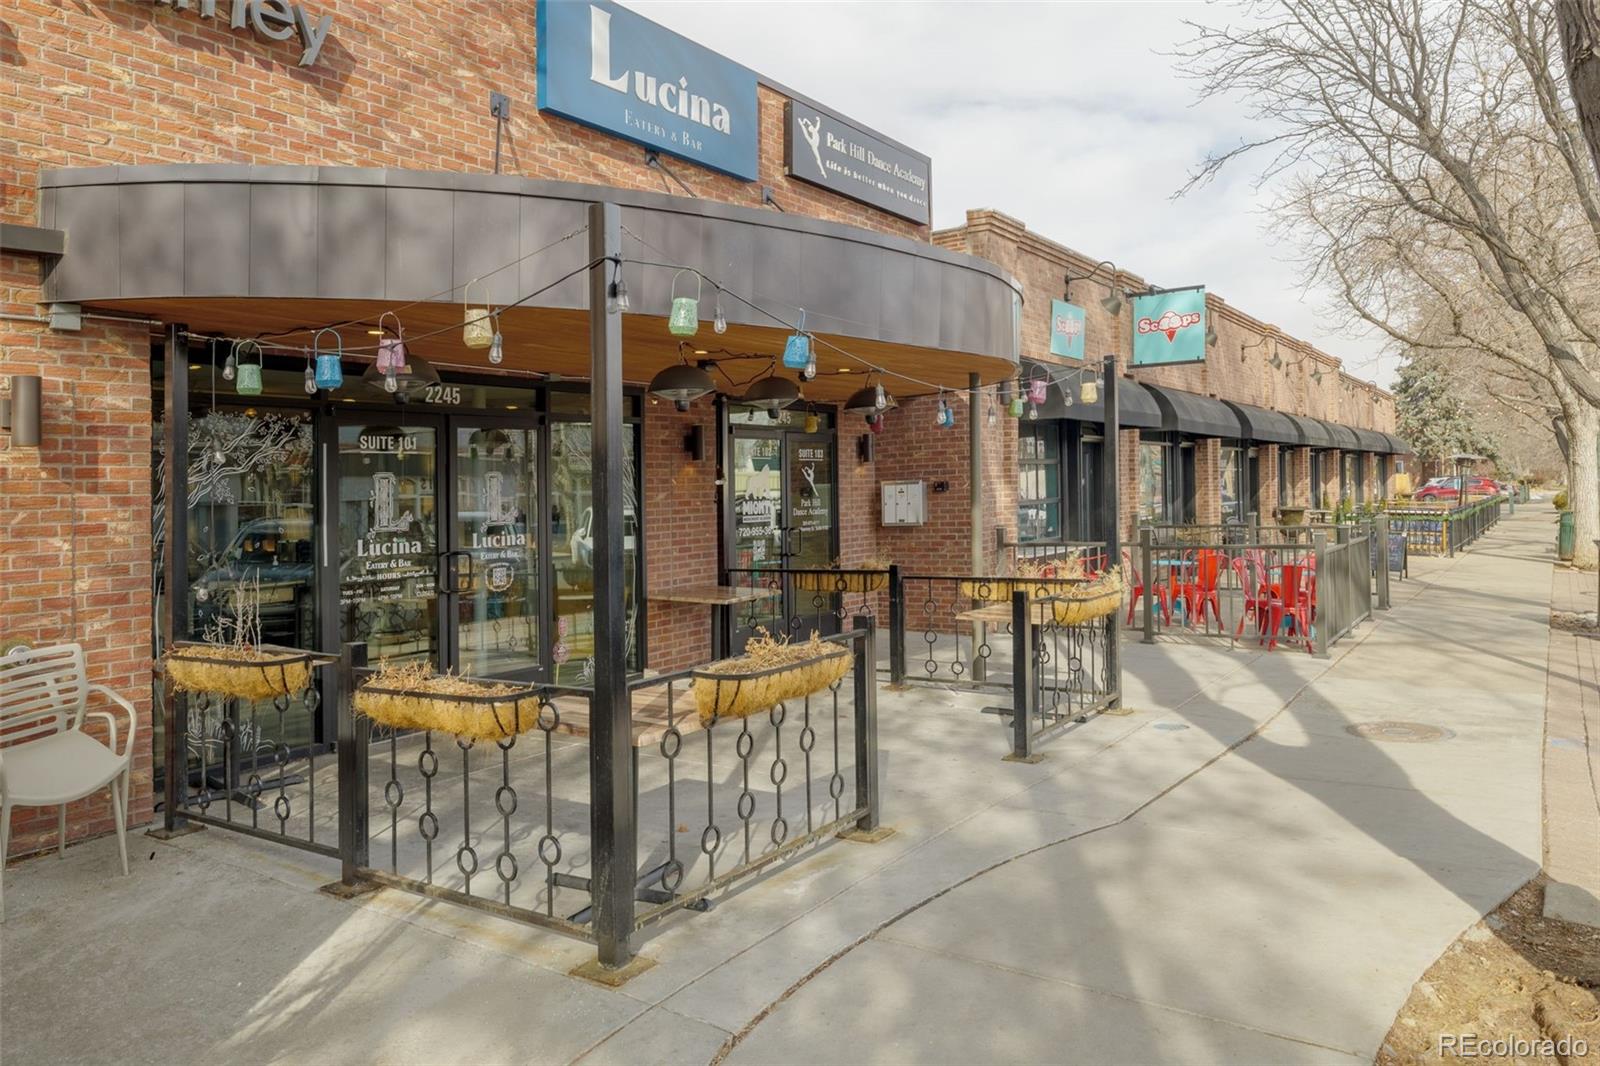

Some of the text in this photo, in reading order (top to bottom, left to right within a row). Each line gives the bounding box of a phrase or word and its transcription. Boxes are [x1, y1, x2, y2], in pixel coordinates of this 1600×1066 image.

[589, 4, 731, 135] Lucina
[671, 131, 677, 144] &
[826, 132, 926, 191] Park Hill Dance Academy
[826, 160, 842, 173] Life
[843, 166, 851, 177] is
[853, 171, 875, 186] better
[877, 182, 895, 194] when
[1137, 311, 1201, 334] Scoops
[425, 387, 461, 405] 2245
[359, 436, 417, 450] SUITE 101
[798, 448, 813, 458] SUITE
[357, 537, 422, 557] Lucina
[472, 531, 526, 549] Lucina
[390, 559, 397, 568] &
[377, 572, 401, 580] HOURS
